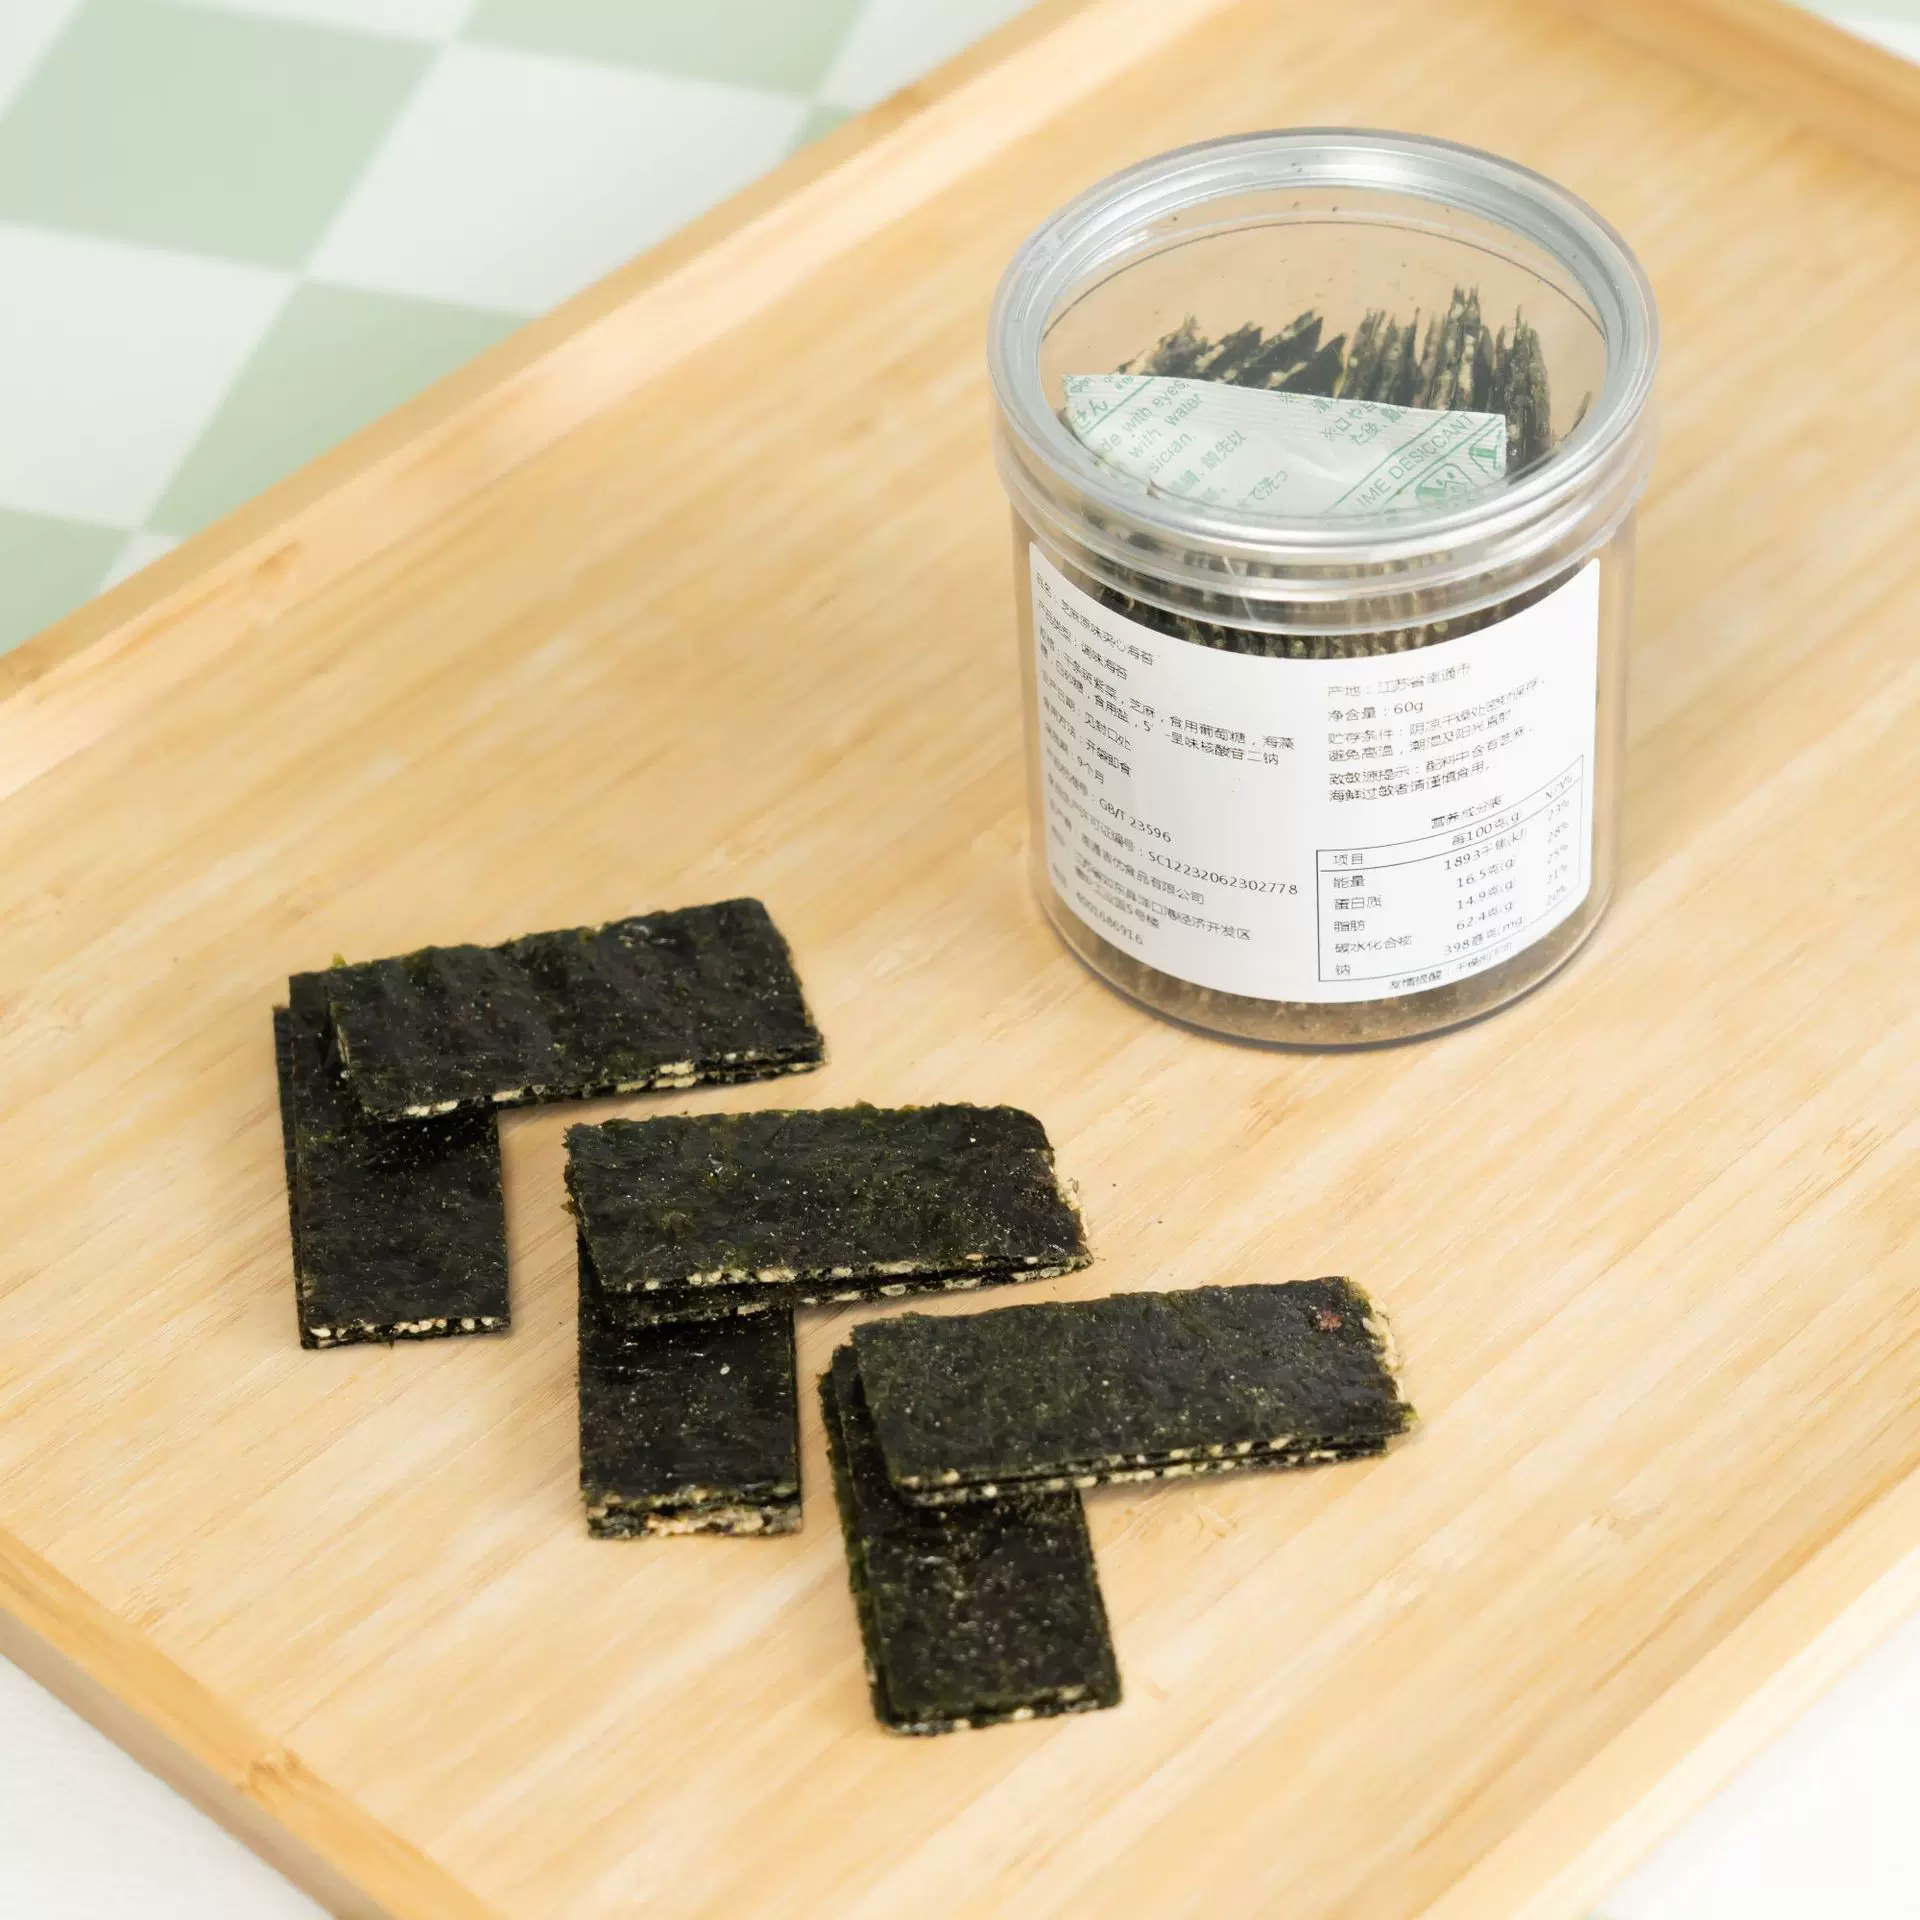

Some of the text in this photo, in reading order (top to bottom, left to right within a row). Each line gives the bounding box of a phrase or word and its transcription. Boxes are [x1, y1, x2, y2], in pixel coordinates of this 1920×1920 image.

[1122, 406, 1153, 436] with
[1127, 393, 1204, 459] with water
[1387, 412, 1477, 481] DESICCANT
[1129, 816, 1172, 843] 23596
[1332, 852, 1365, 866] 项目
[1332, 875, 1366, 889] 能量
[1333, 895, 1383, 911] 蛋白质
[1333, 919, 1366, 933] 脂肪
[1334, 934, 1413, 954] 碳水化合物
[1335, 963, 1351, 976] 钠
